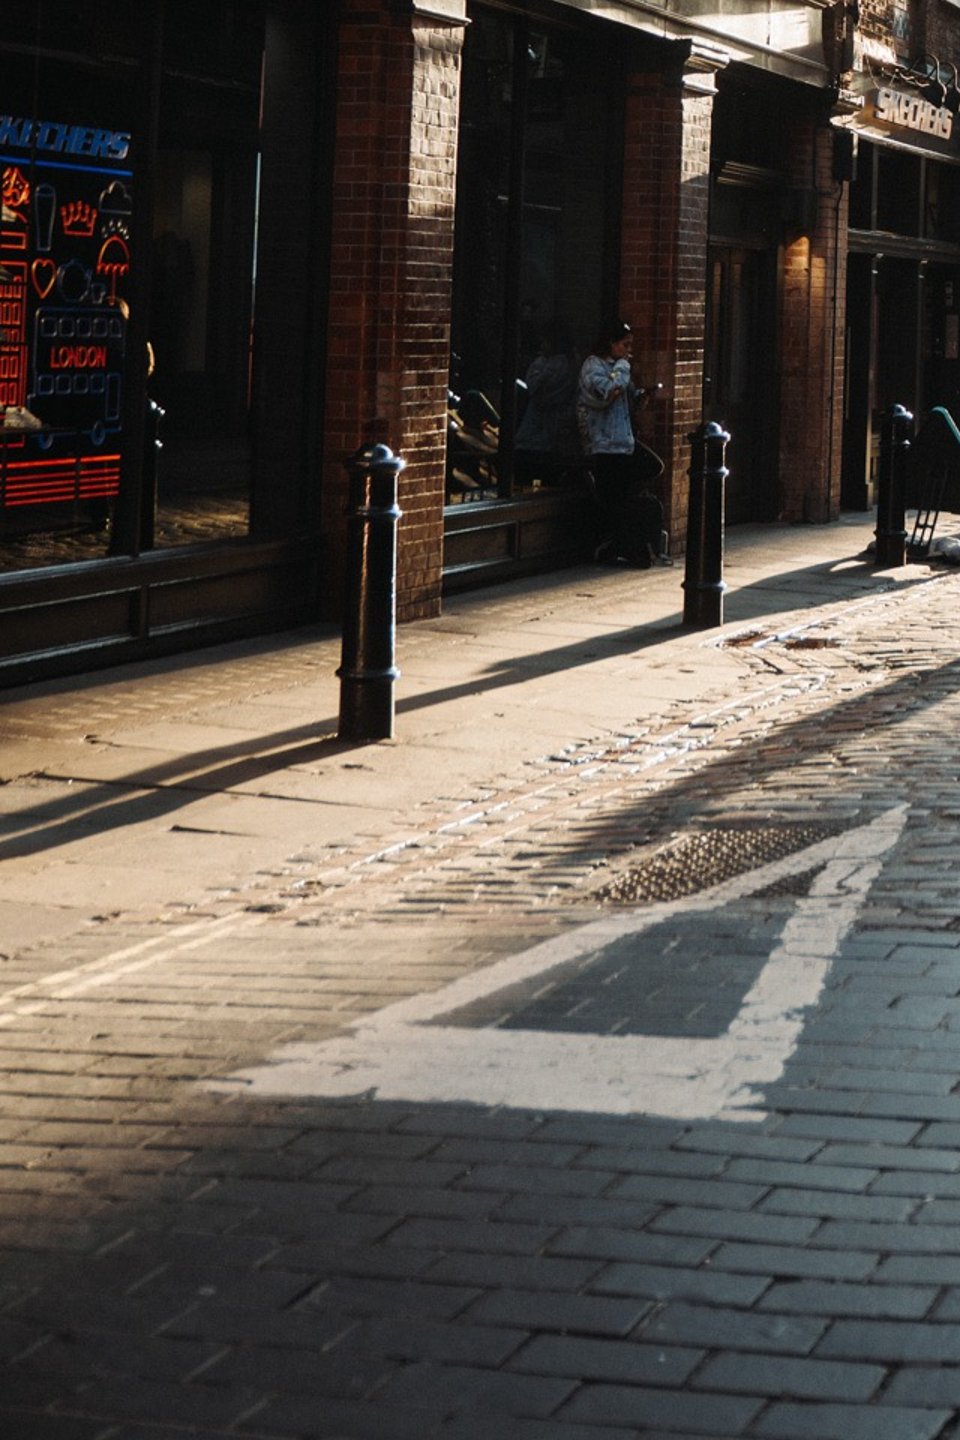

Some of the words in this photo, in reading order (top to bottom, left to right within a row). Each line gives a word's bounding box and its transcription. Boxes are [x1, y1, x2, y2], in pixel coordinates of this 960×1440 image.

[875, 86, 954, 140] SKECHERS
[0, 114, 131, 160] KECHERS
[50, 345, 107, 369] LONDON
